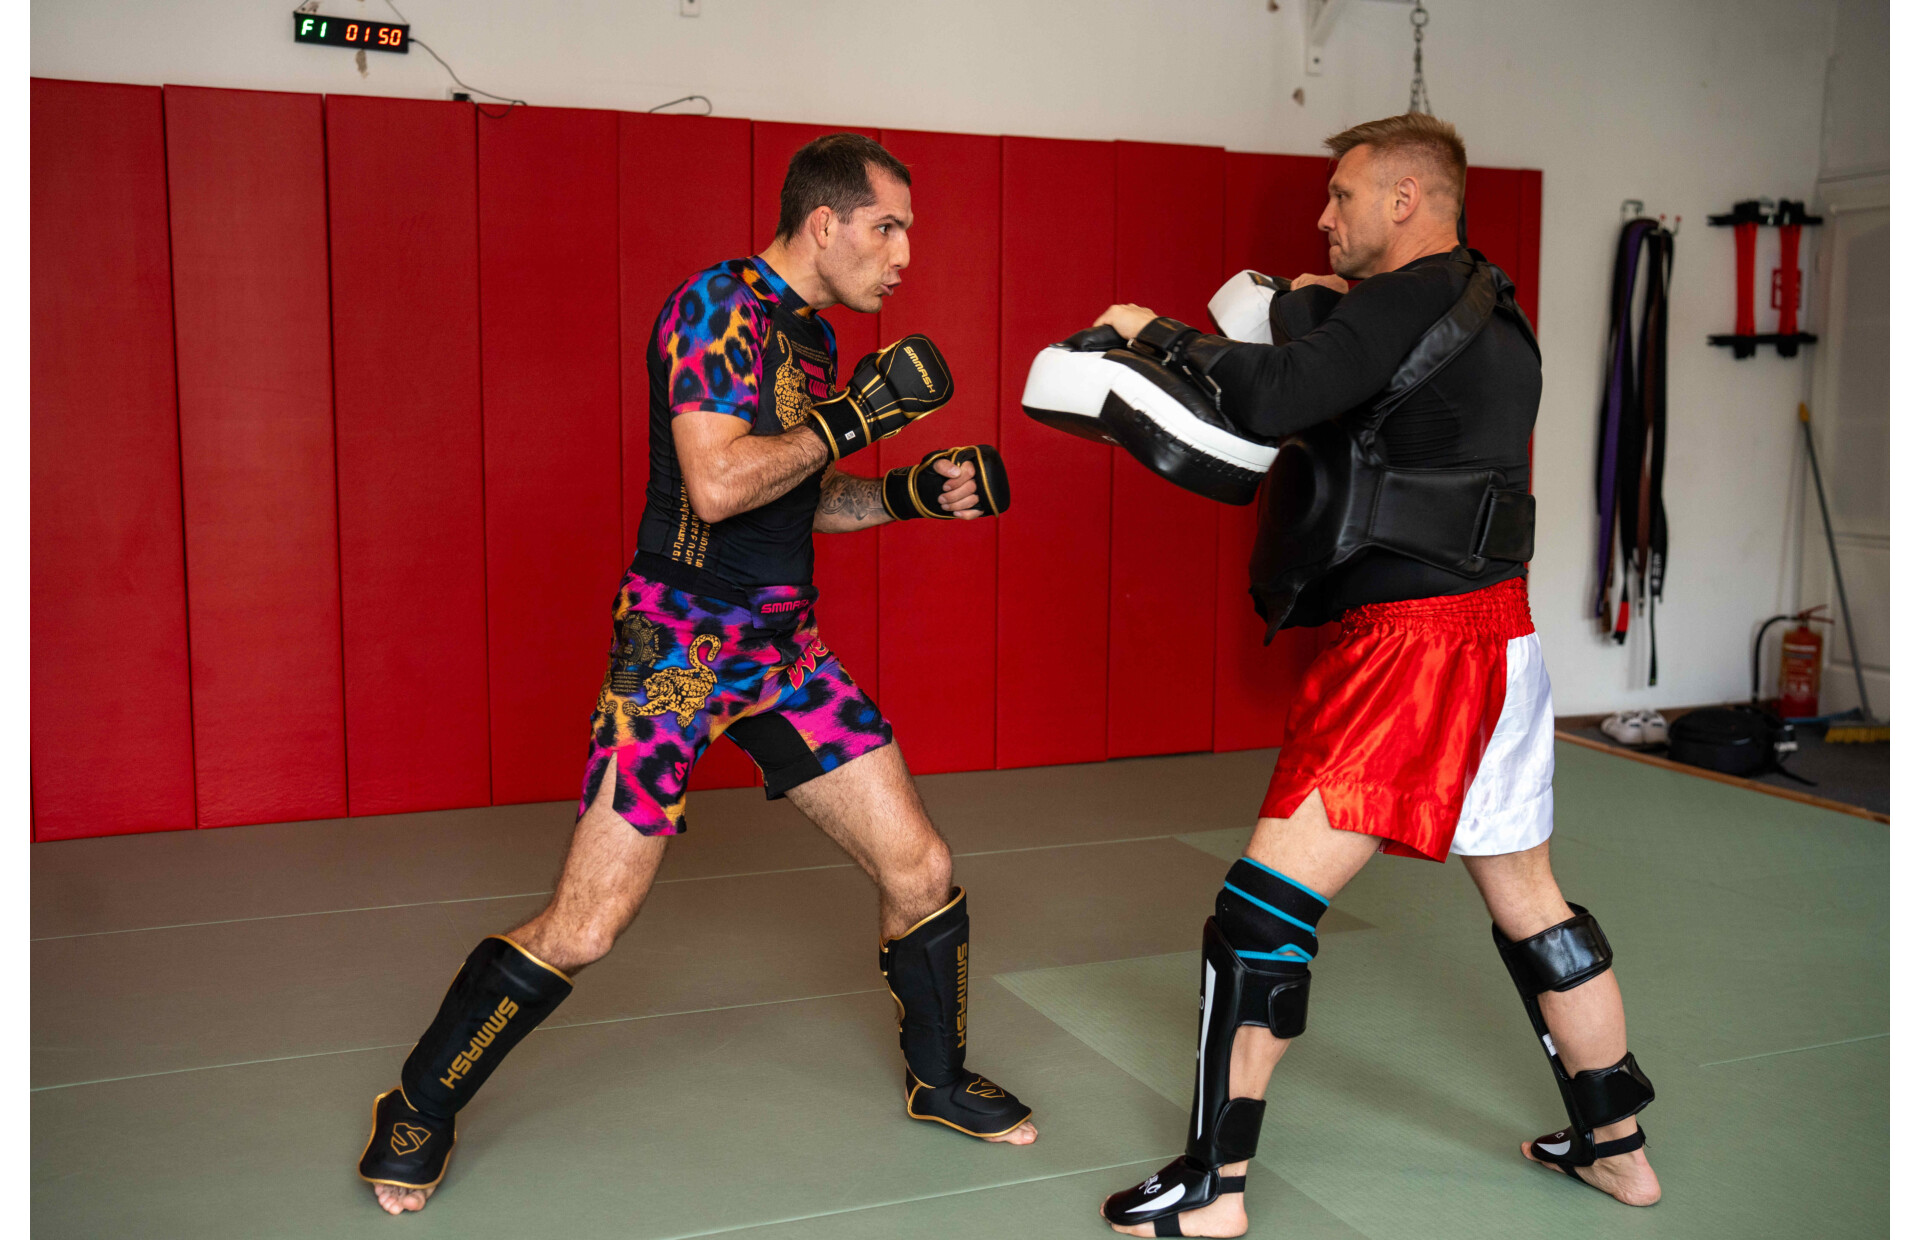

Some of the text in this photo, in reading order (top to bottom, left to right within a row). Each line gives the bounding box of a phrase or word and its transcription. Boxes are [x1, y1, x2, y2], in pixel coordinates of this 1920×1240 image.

[903, 346, 936, 393] SMMASH
[760, 600, 809, 614] SMMA
[957, 942, 967, 1048] SMMASH
[439, 996, 519, 1090] SMMASH
